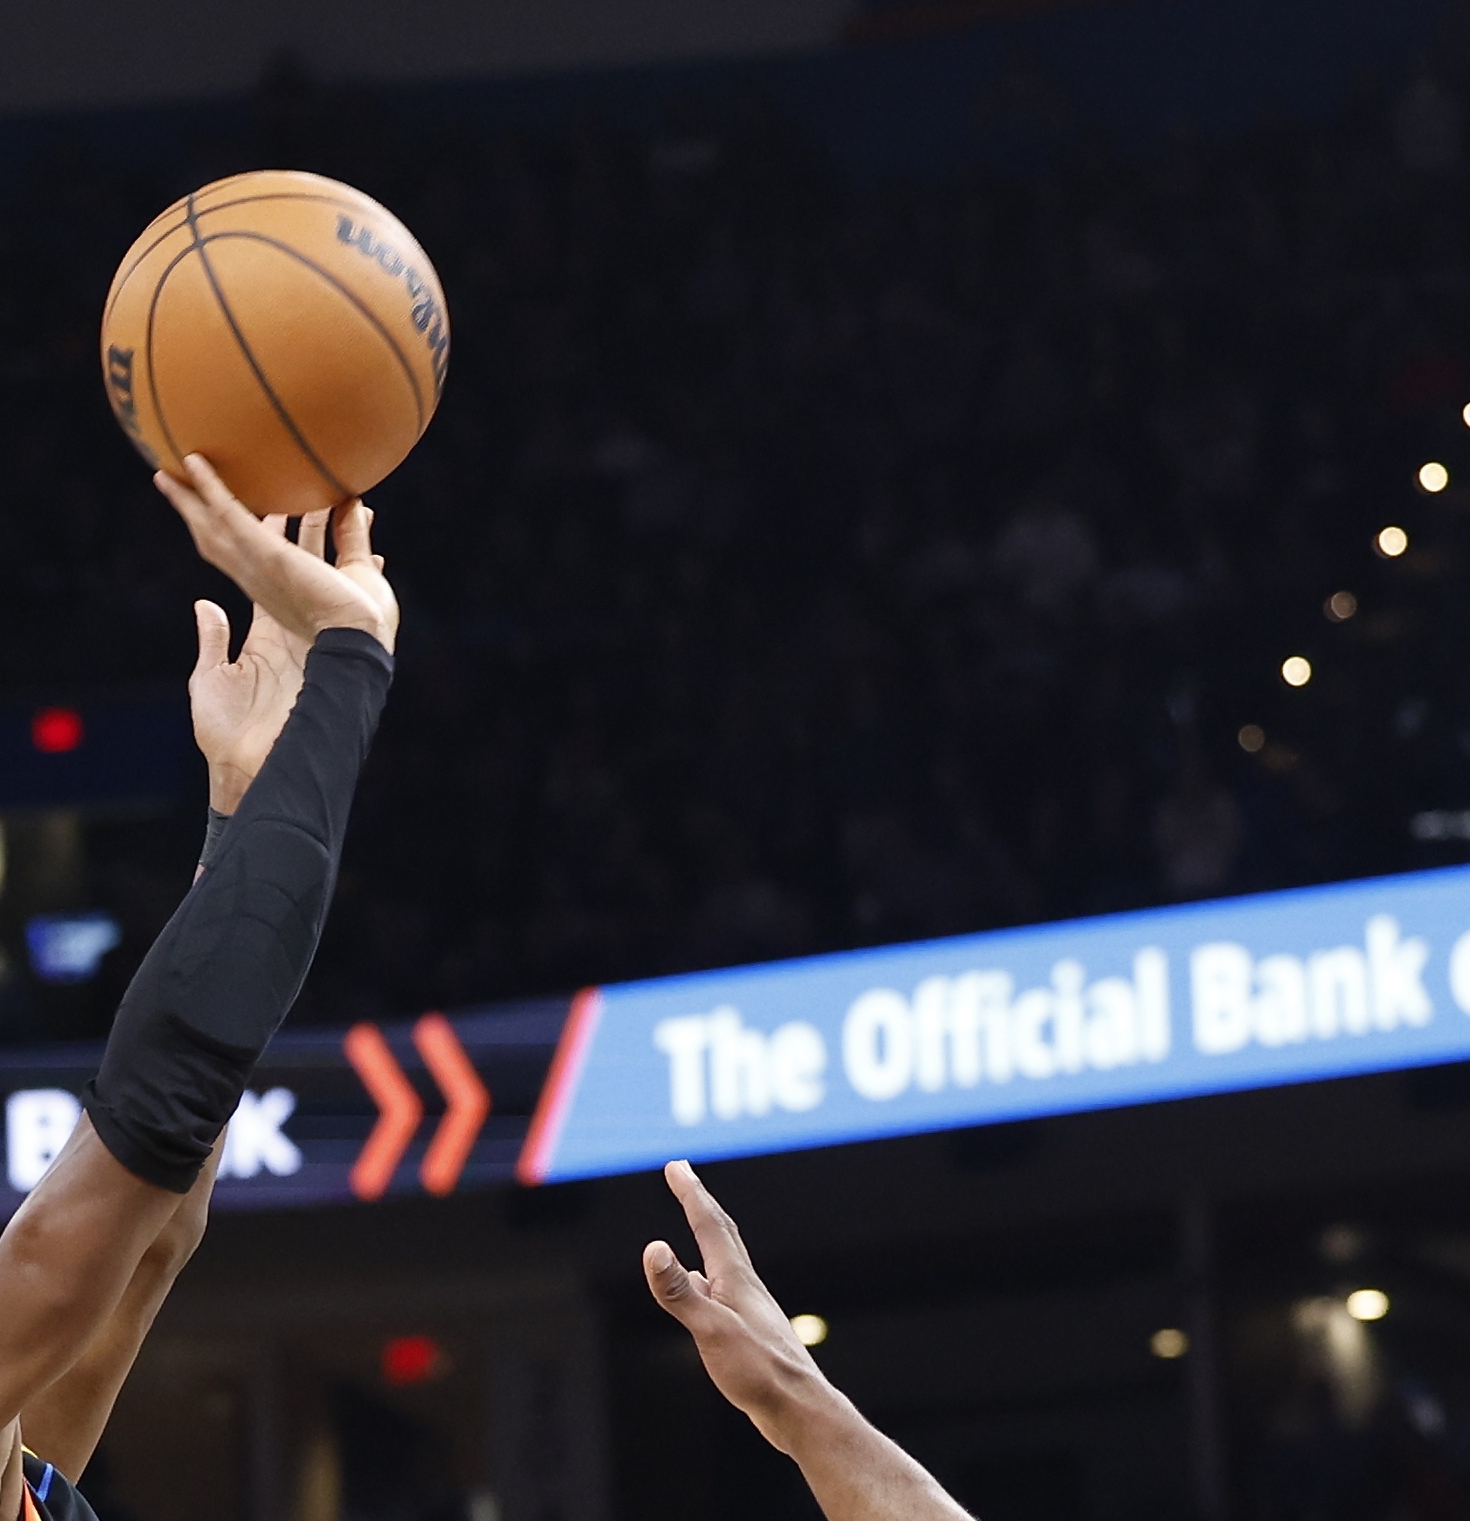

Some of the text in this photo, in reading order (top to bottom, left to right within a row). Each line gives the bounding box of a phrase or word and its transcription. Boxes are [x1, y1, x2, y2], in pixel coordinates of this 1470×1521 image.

[655, 1006, 827, 1127] The
[843, 945, 1171, 1101] Official
[1191, 912, 1433, 1055] Bank
[5, 1087, 303, 1192] BK
